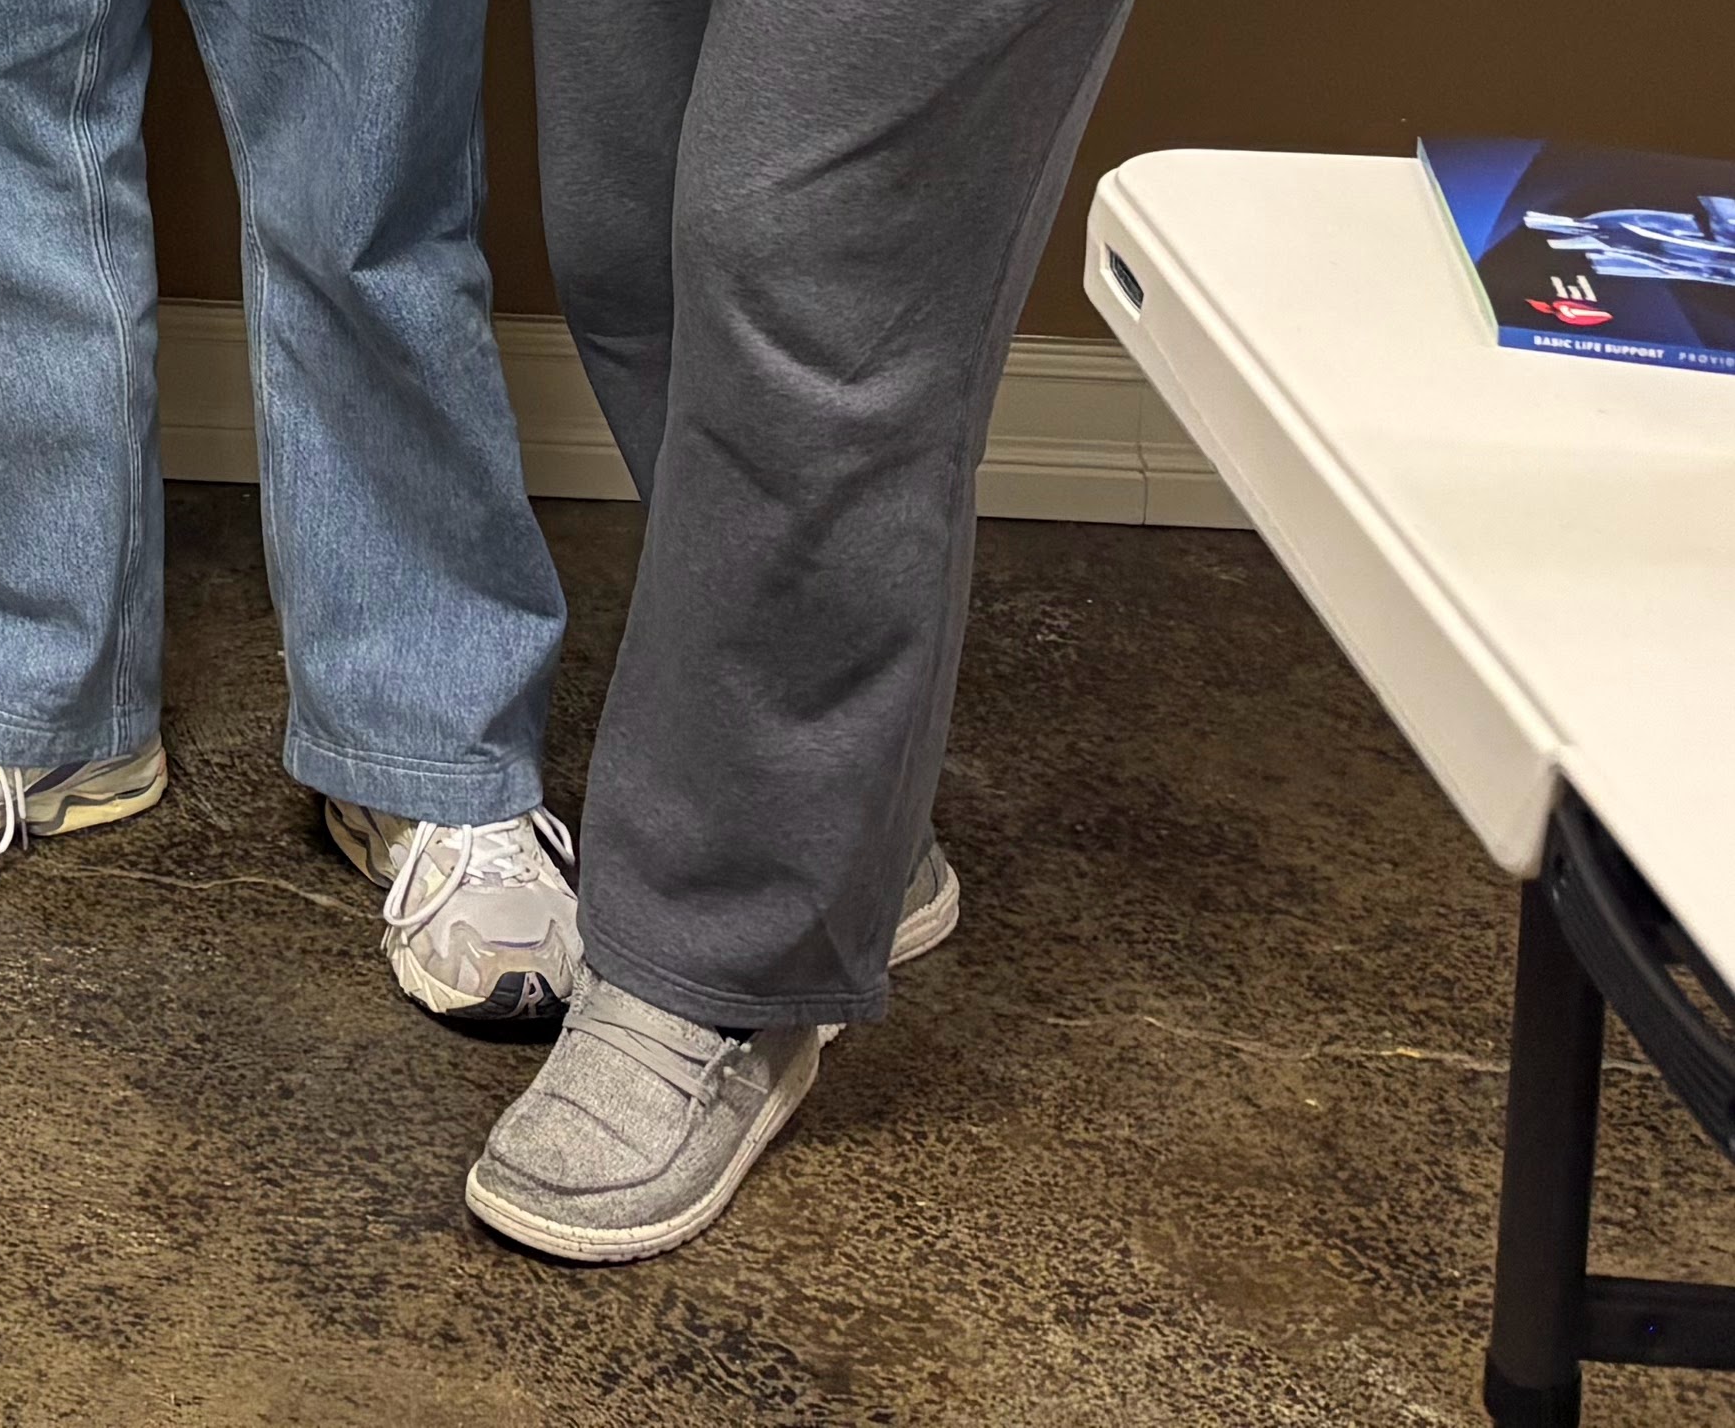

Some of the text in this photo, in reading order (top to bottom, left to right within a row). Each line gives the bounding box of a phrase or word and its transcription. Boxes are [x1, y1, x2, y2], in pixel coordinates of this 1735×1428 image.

[1533, 334, 1572, 349] BASIC
[1574, 340, 1602, 353] LIFE
[1604, 343, 1665, 359] SUPPORT
